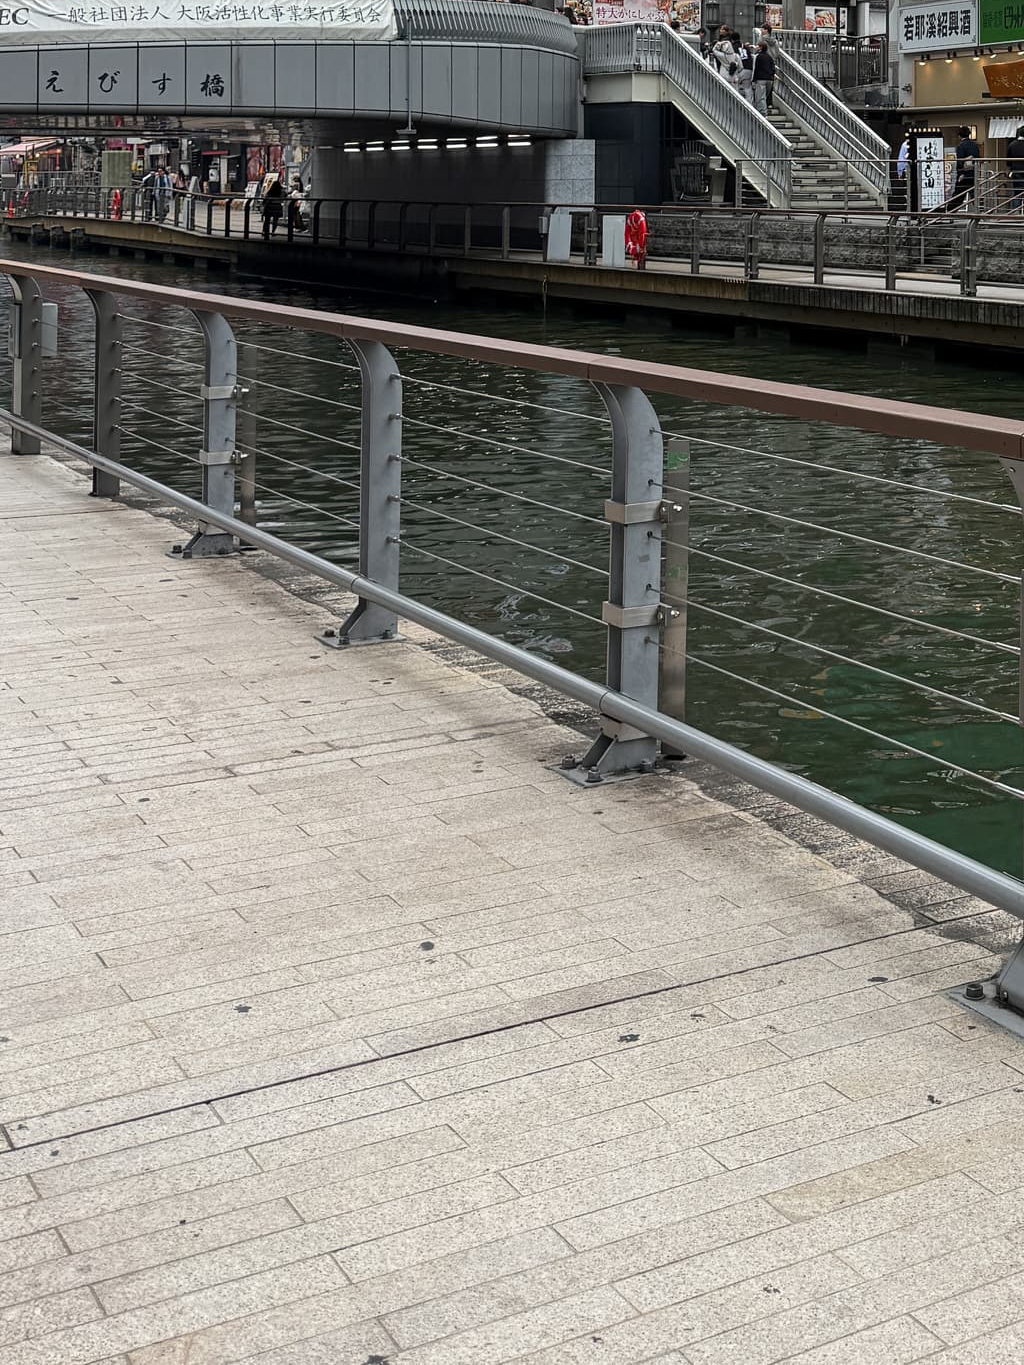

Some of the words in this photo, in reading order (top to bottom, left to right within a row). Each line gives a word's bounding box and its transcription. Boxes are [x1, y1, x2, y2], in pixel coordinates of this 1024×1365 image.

[47, 5, 170, 23] 一般社団法人
[45, 70, 225, 97] えびす橋
